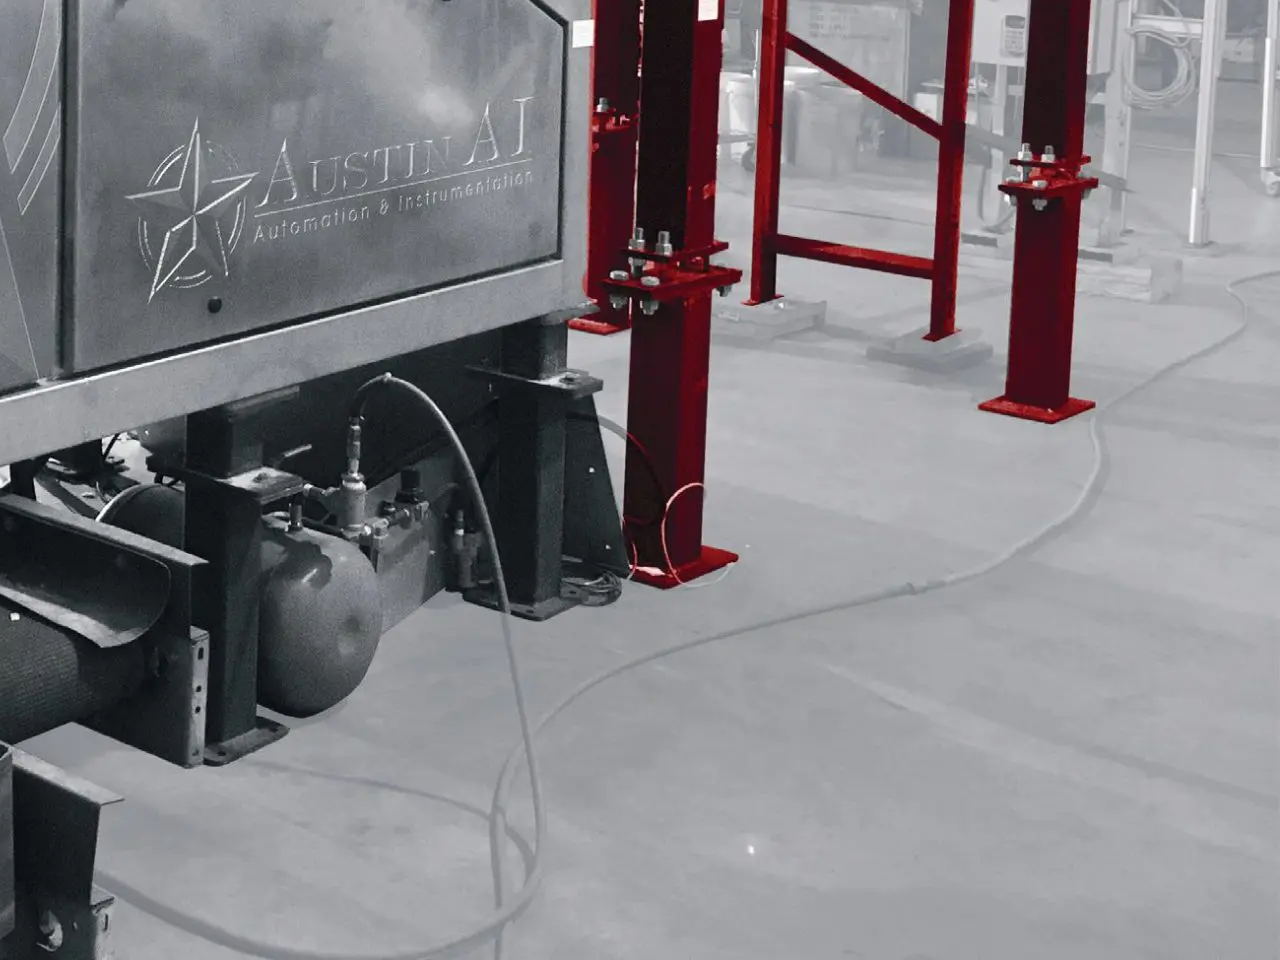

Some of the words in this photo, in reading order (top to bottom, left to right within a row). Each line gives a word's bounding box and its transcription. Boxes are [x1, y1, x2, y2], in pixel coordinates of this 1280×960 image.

[252, 205, 370, 245] Automation
[379, 197, 390, 216] &
[397, 169, 534, 212] Instrumentation
